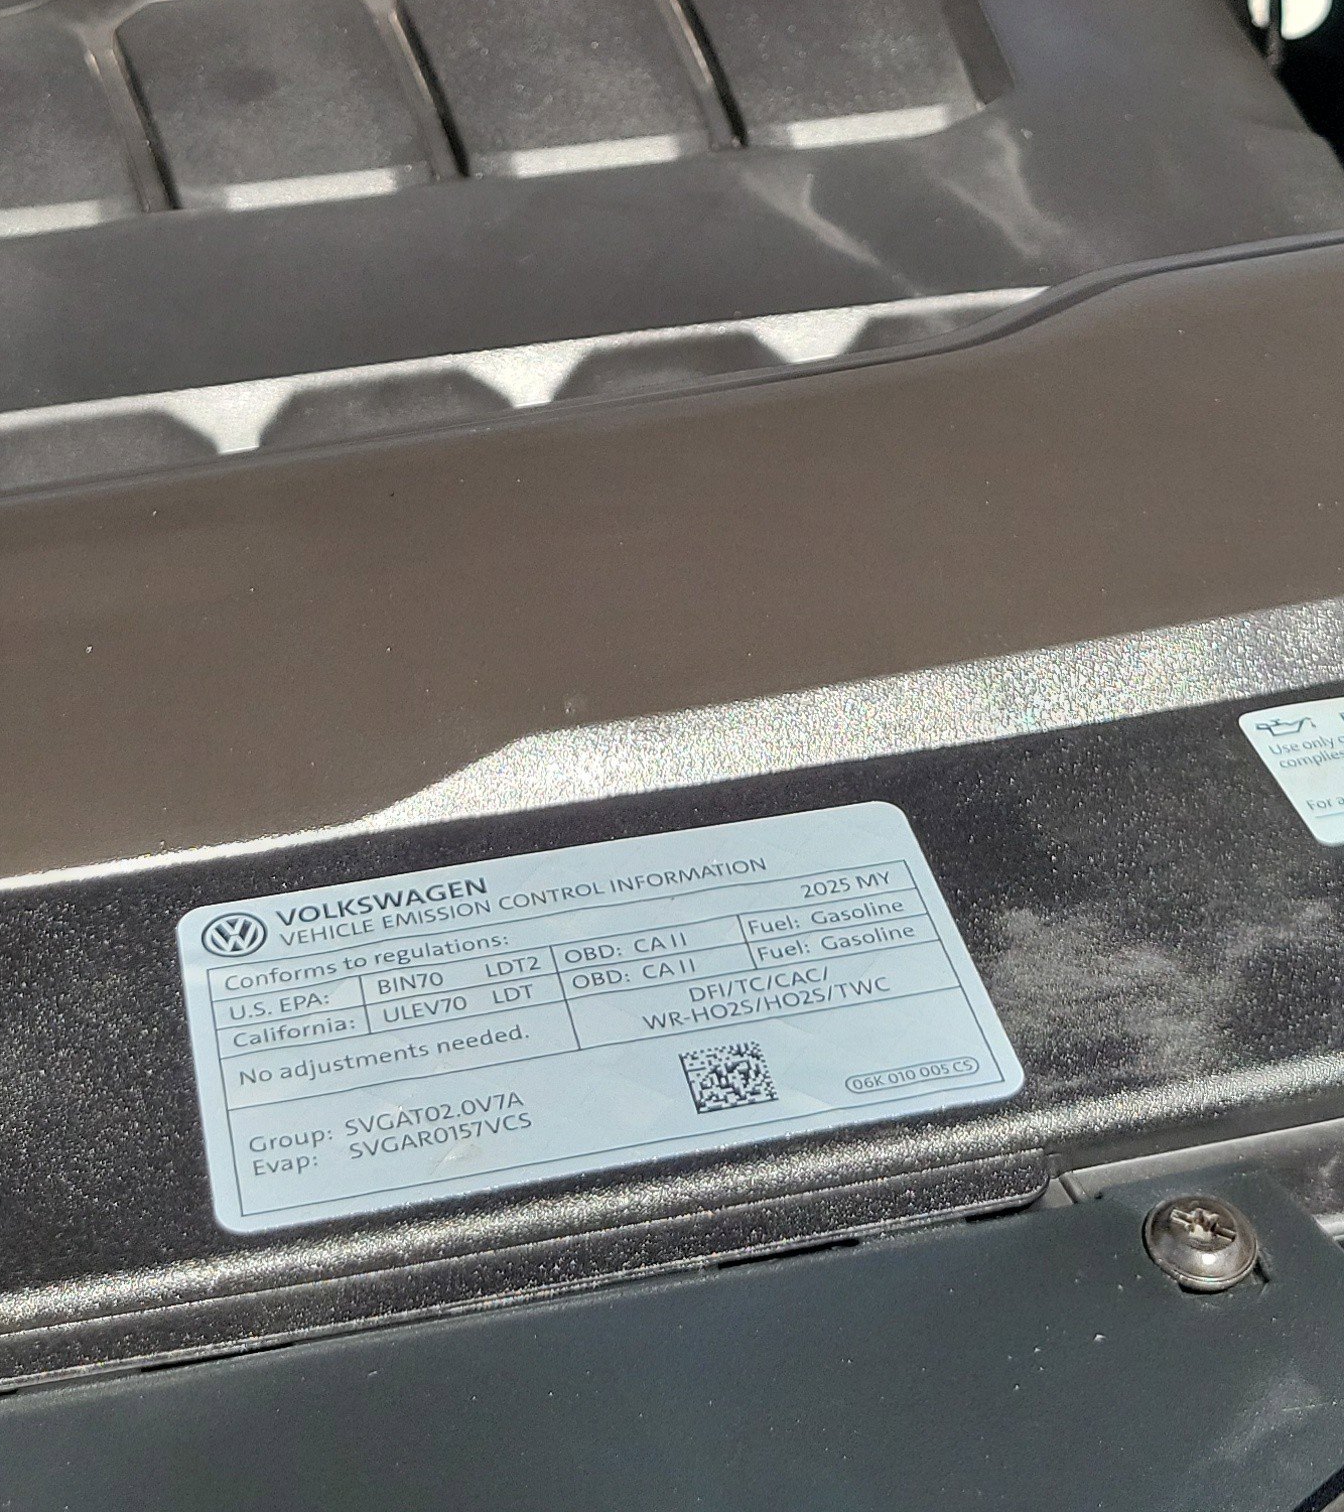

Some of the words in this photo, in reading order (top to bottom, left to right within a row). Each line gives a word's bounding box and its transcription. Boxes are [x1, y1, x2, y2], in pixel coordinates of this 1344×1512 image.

[1267, 743, 1300, 755] Use
[1301, 735, 1334, 749] only
[1305, 799, 1332, 810] For
[800, 877, 851, 898] 2025
[854, 870, 889, 889] MY
[276, 877, 488, 926] VOLKSWAGEN
[279, 918, 374, 946] VEHICLE
[381, 899, 491, 929] EMISSION
[498, 882, 604, 910] CONTROL
[609, 857, 766, 892] INFORMATION
[747, 914, 800, 935] Fuel:
[810, 901, 903, 924] Gasoline
[564, 944, 621, 963] OBD:
[633, 936, 666, 953] CA
[756, 939, 810, 961] Fuel:
[820, 926, 914, 950] Gasoline
[224, 962, 337, 991] Conforms
[342, 956, 367, 970] to
[374, 935, 508, 965] regulations:
[377, 971, 443, 995] BIN70
[484, 955, 541, 978] LDT2
[571, 969, 630, 989] OBD:
[641, 962, 675, 979] CA
[688, 966, 827, 1002] DFI/TC/CAC/
[228, 1001, 272, 1020] U.S.
[279, 992, 329, 1013] EPA:
[382, 995, 467, 1023] ULEV70
[491, 983, 532, 1004] LDT
[642, 976, 889, 1029] WR-HO2S/HO2S/TWC
[232, 1017, 355, 1047] California:
[238, 1068, 272, 1085] No
[280, 1043, 429, 1081] adjustments
[436, 1023, 529, 1053] needed.
[848, 1073, 885, 1093] 06K
[887, 1066, 921, 1084] 010
[918, 1063, 950, 1081] 005
[248, 1129, 332, 1153] Group:
[252, 1155, 317, 1176] Evap:
